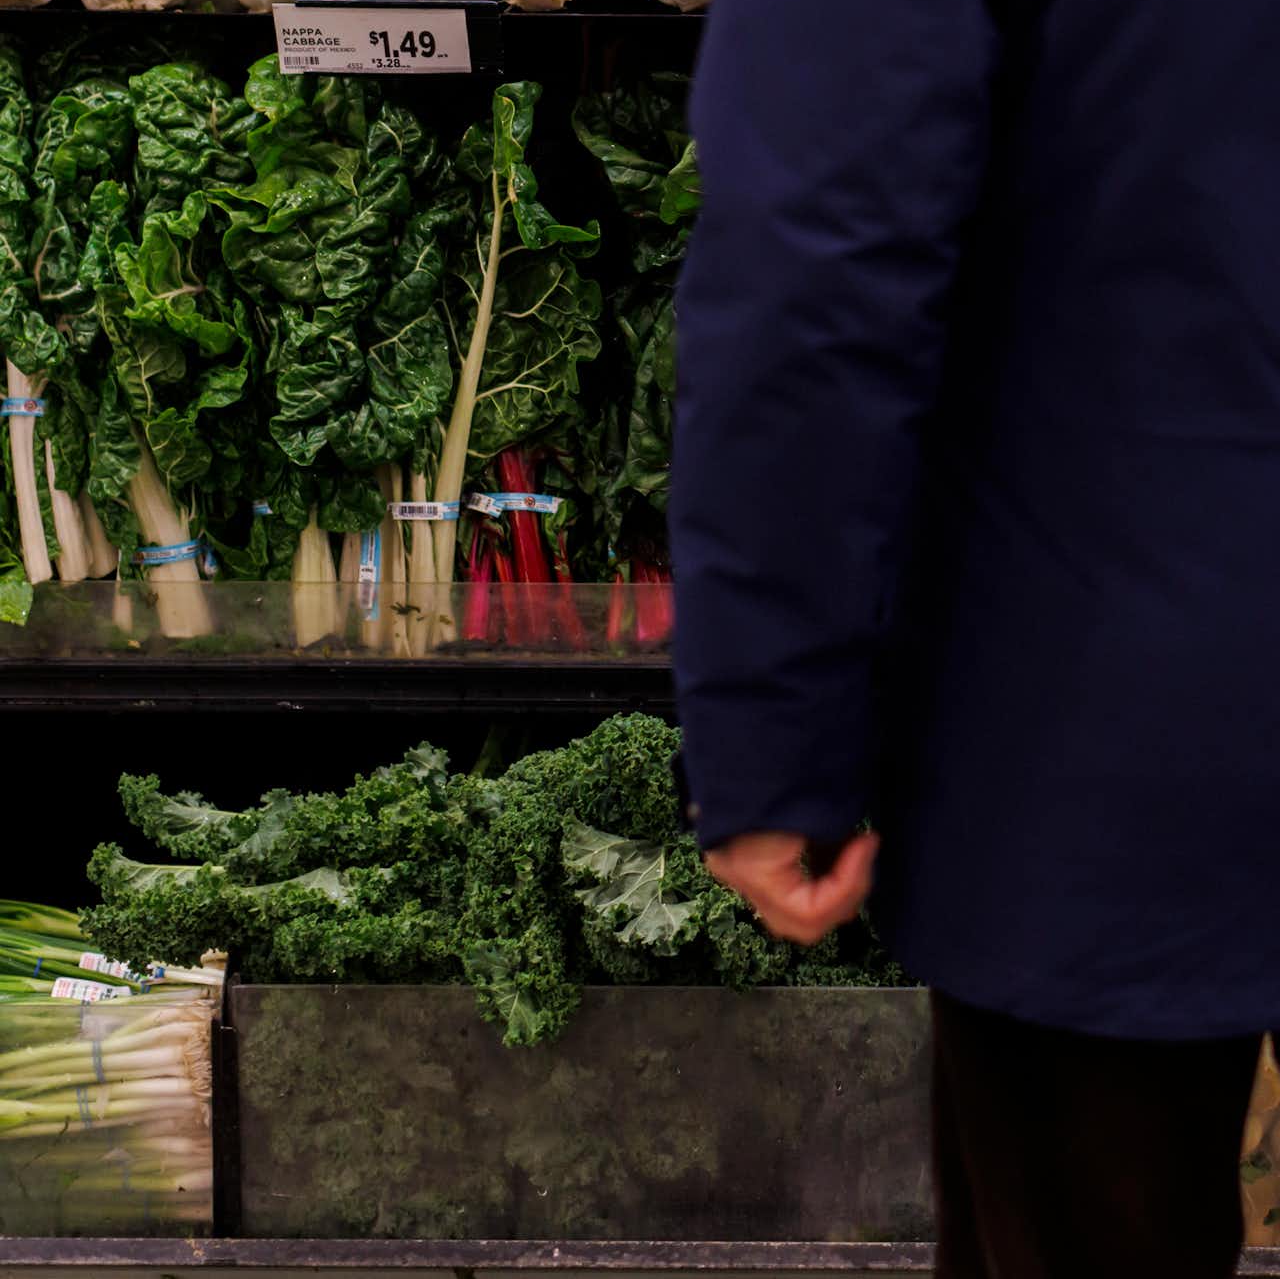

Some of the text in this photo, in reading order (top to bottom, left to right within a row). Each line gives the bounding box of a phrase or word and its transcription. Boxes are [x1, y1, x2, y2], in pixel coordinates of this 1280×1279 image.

[282, 27, 322, 36] NAPPA
[283, 37, 341, 46] CABBAGE
[369, 30, 436, 58] $1.49
[371, 58, 401, 68] $3.28
